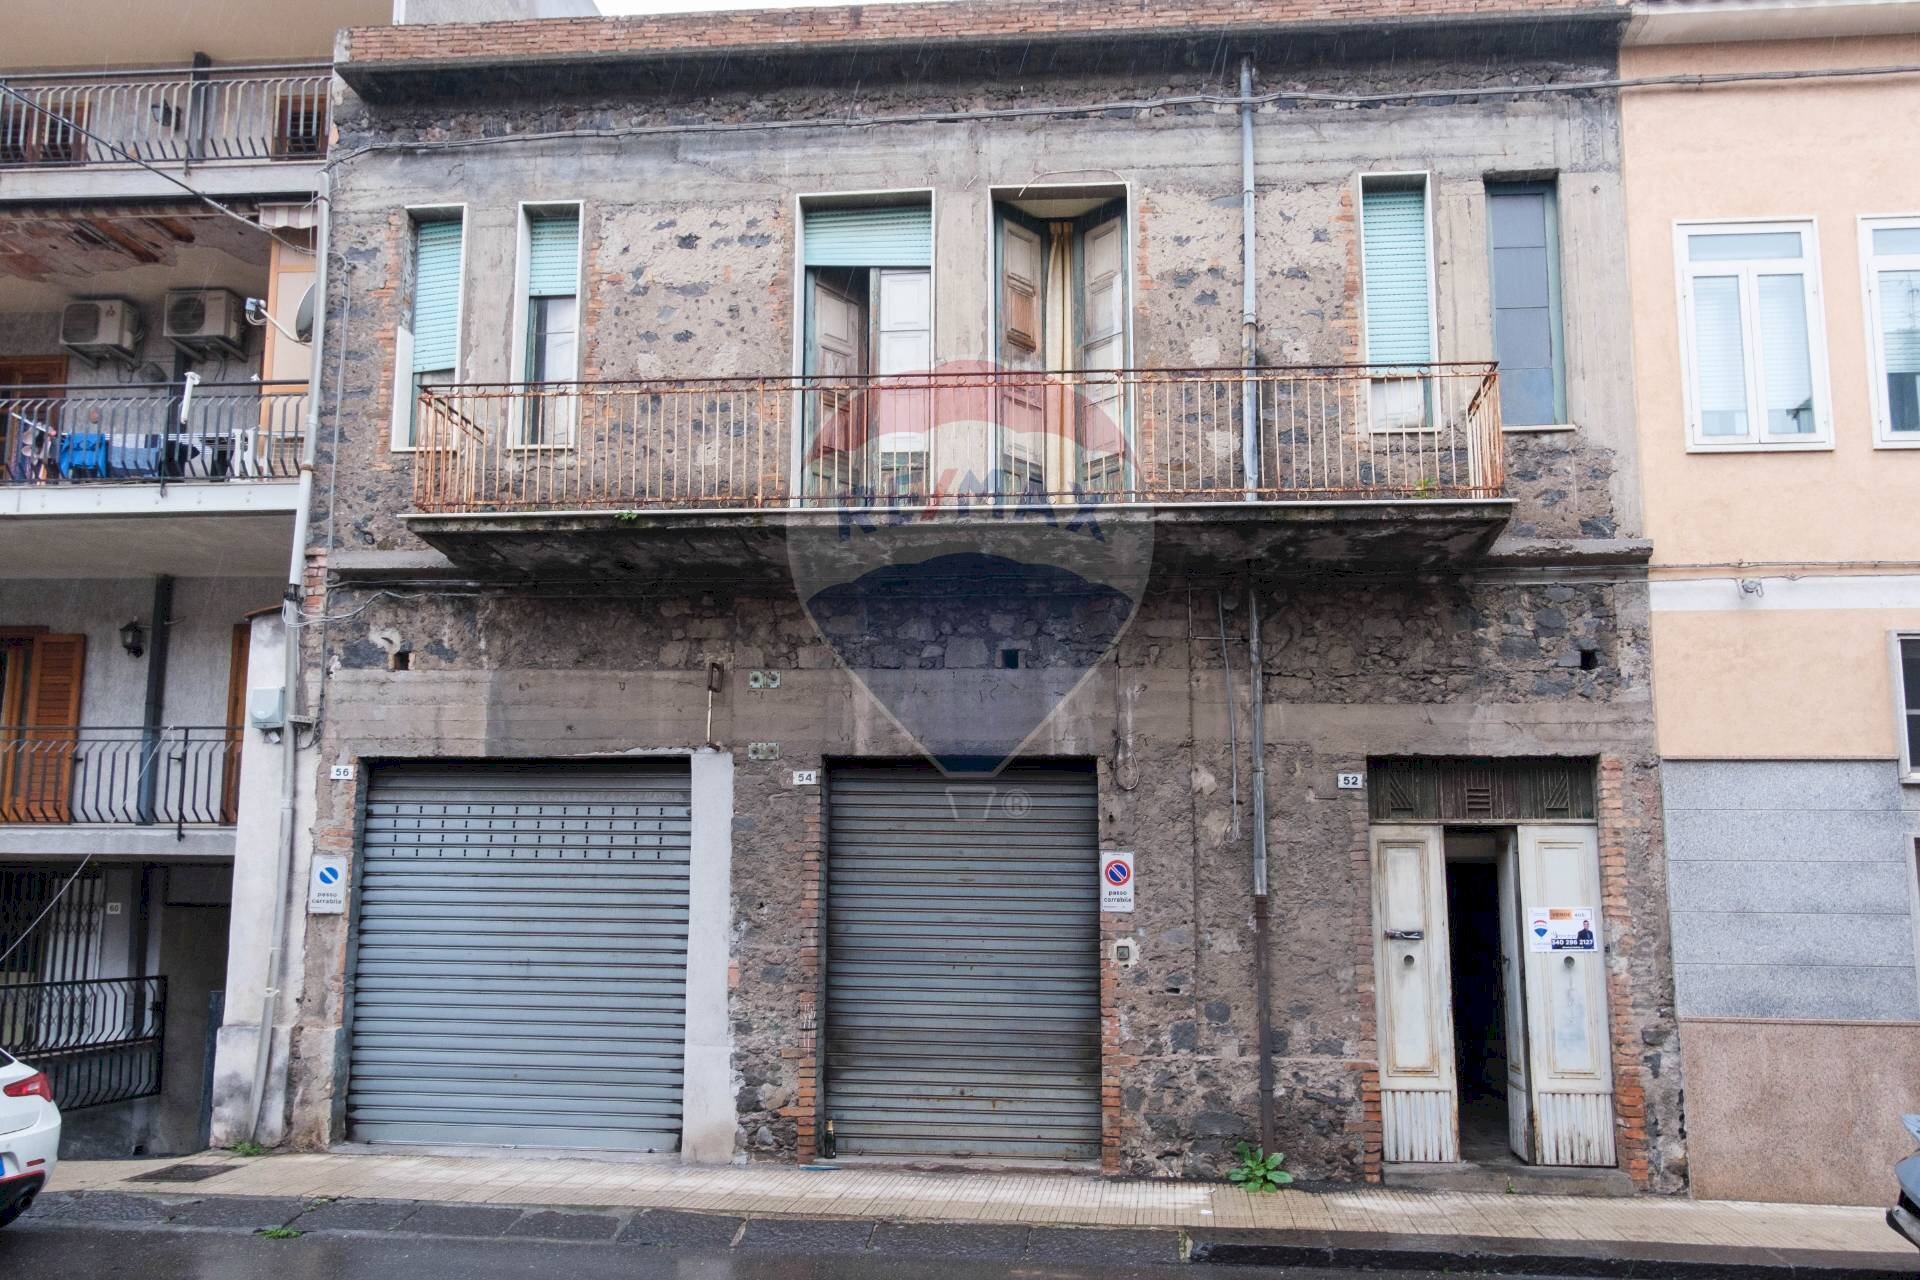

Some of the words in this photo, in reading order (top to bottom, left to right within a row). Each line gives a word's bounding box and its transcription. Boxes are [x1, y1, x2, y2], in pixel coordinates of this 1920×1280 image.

[335, 768, 349, 777] 56
[798, 773, 812, 782] 54
[1343, 776, 1359, 786] 52
